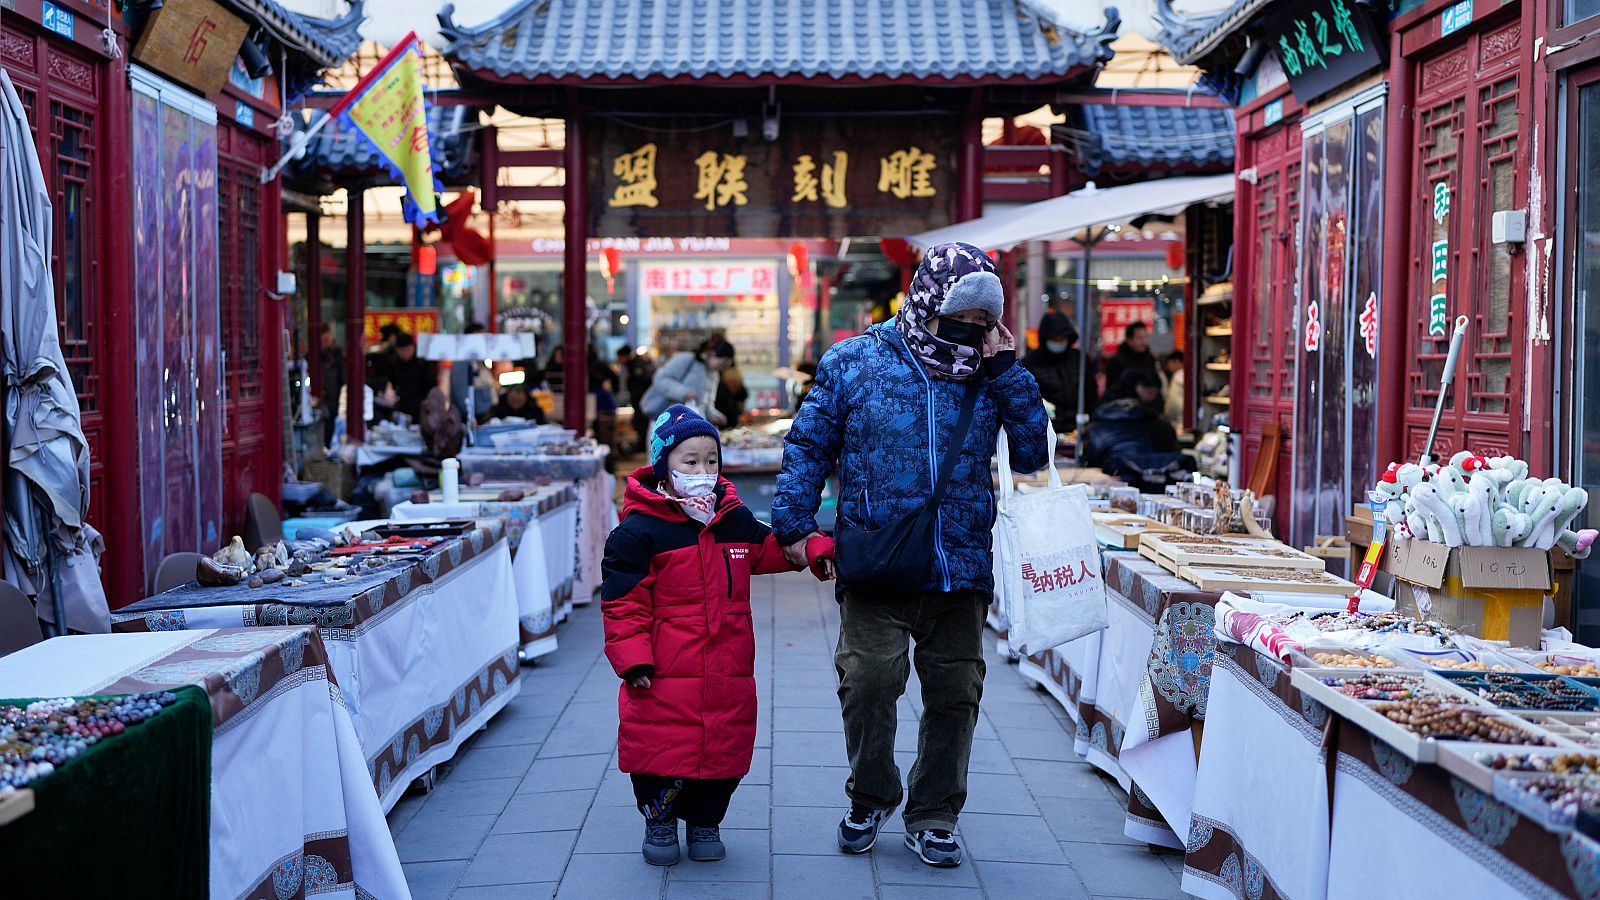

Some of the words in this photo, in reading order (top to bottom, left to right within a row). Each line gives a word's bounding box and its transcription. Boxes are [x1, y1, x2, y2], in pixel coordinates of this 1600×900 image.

[1021, 560, 1096, 594] 是纳税人
[1480, 562, 1526, 577] 10元
